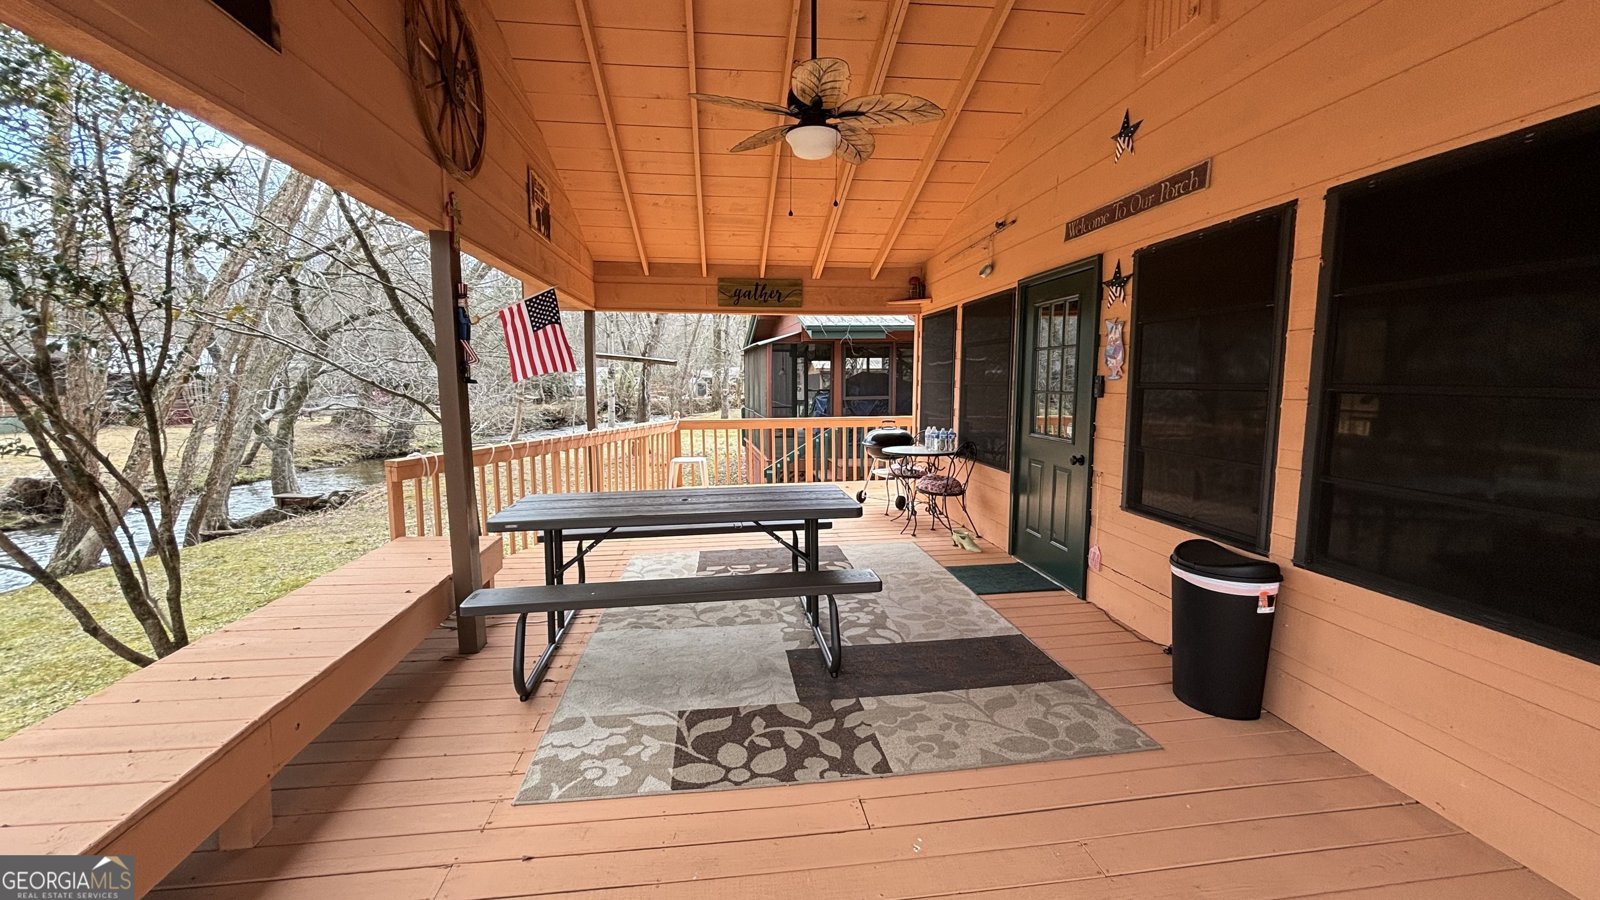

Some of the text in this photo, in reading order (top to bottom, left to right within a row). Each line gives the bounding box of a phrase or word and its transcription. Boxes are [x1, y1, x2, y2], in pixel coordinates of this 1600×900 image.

[1068, 170, 1199, 238] Welcome To Our Porch
[732, 282, 784, 305] gather
